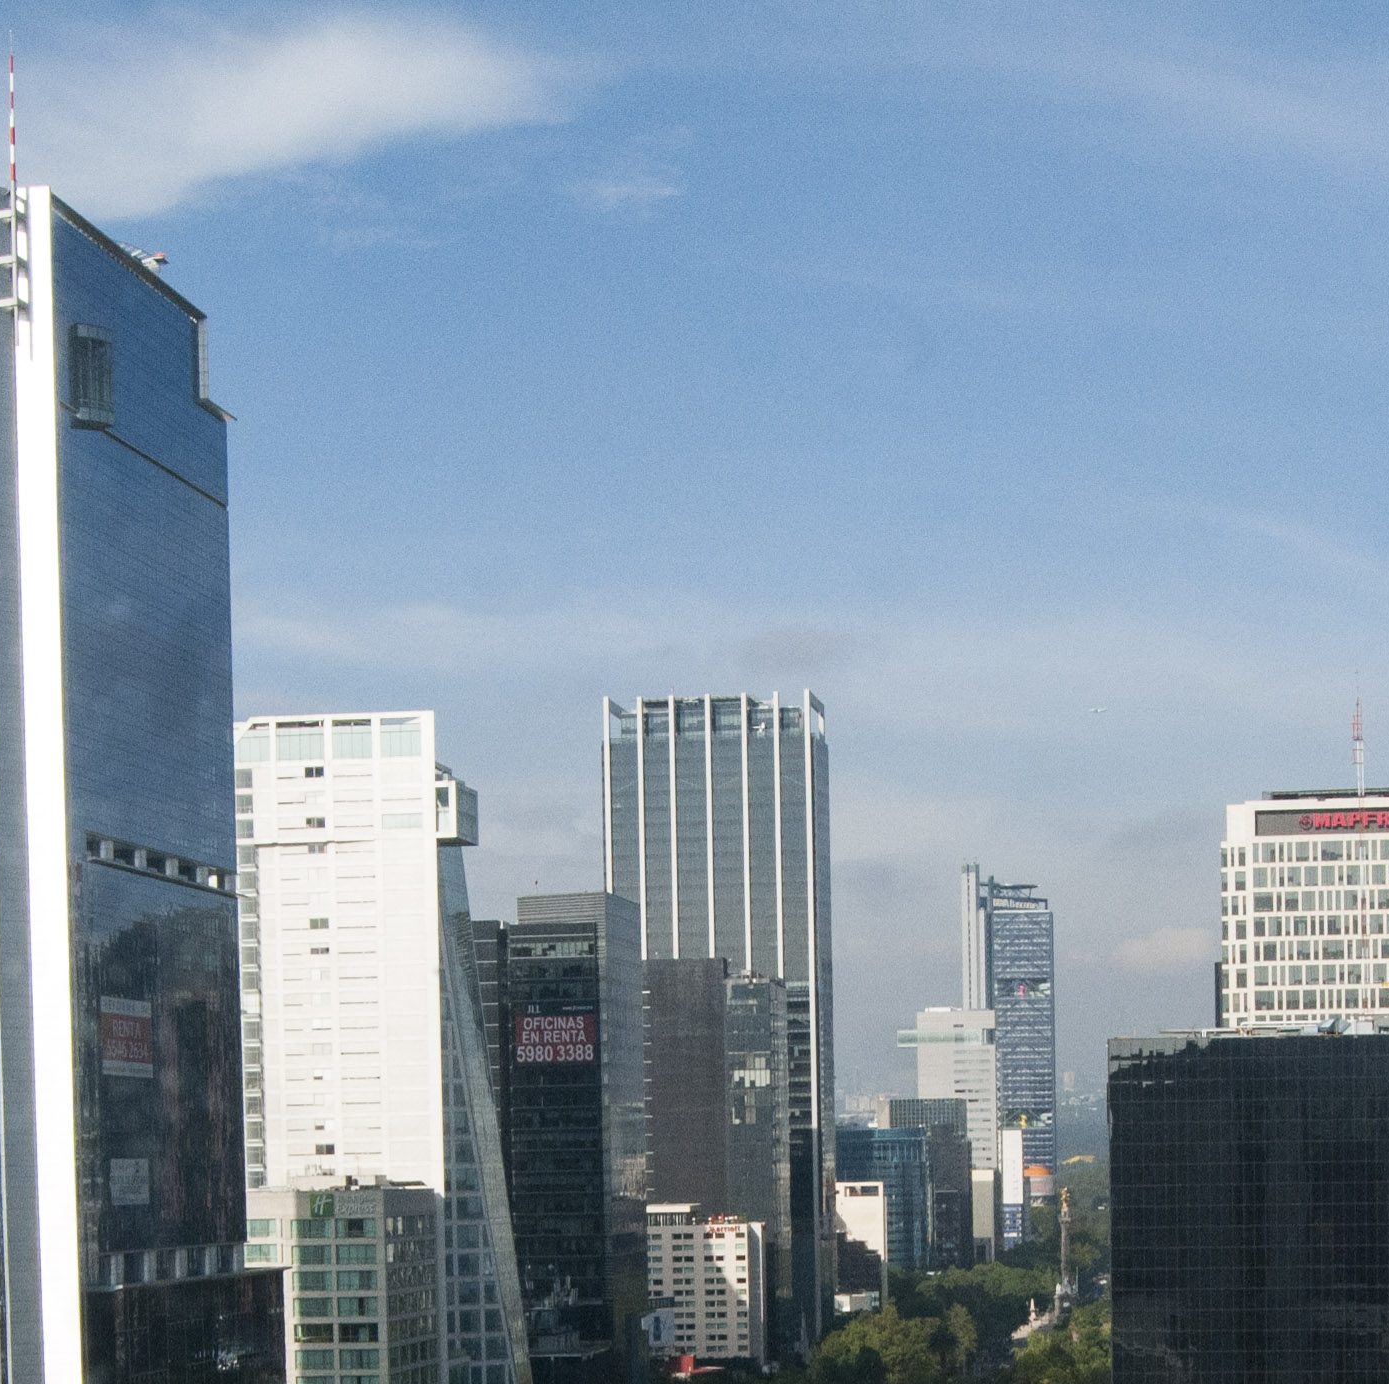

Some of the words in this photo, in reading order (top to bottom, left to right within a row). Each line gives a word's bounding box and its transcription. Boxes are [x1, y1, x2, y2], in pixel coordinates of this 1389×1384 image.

[523, 1016, 585, 1030] OFICINAS
[522, 1031, 540, 1044] EN
[543, 1029, 587, 1043] RENTA
[516, 1045, 554, 1062] 5980
[556, 1044, 595, 1061] 3388
